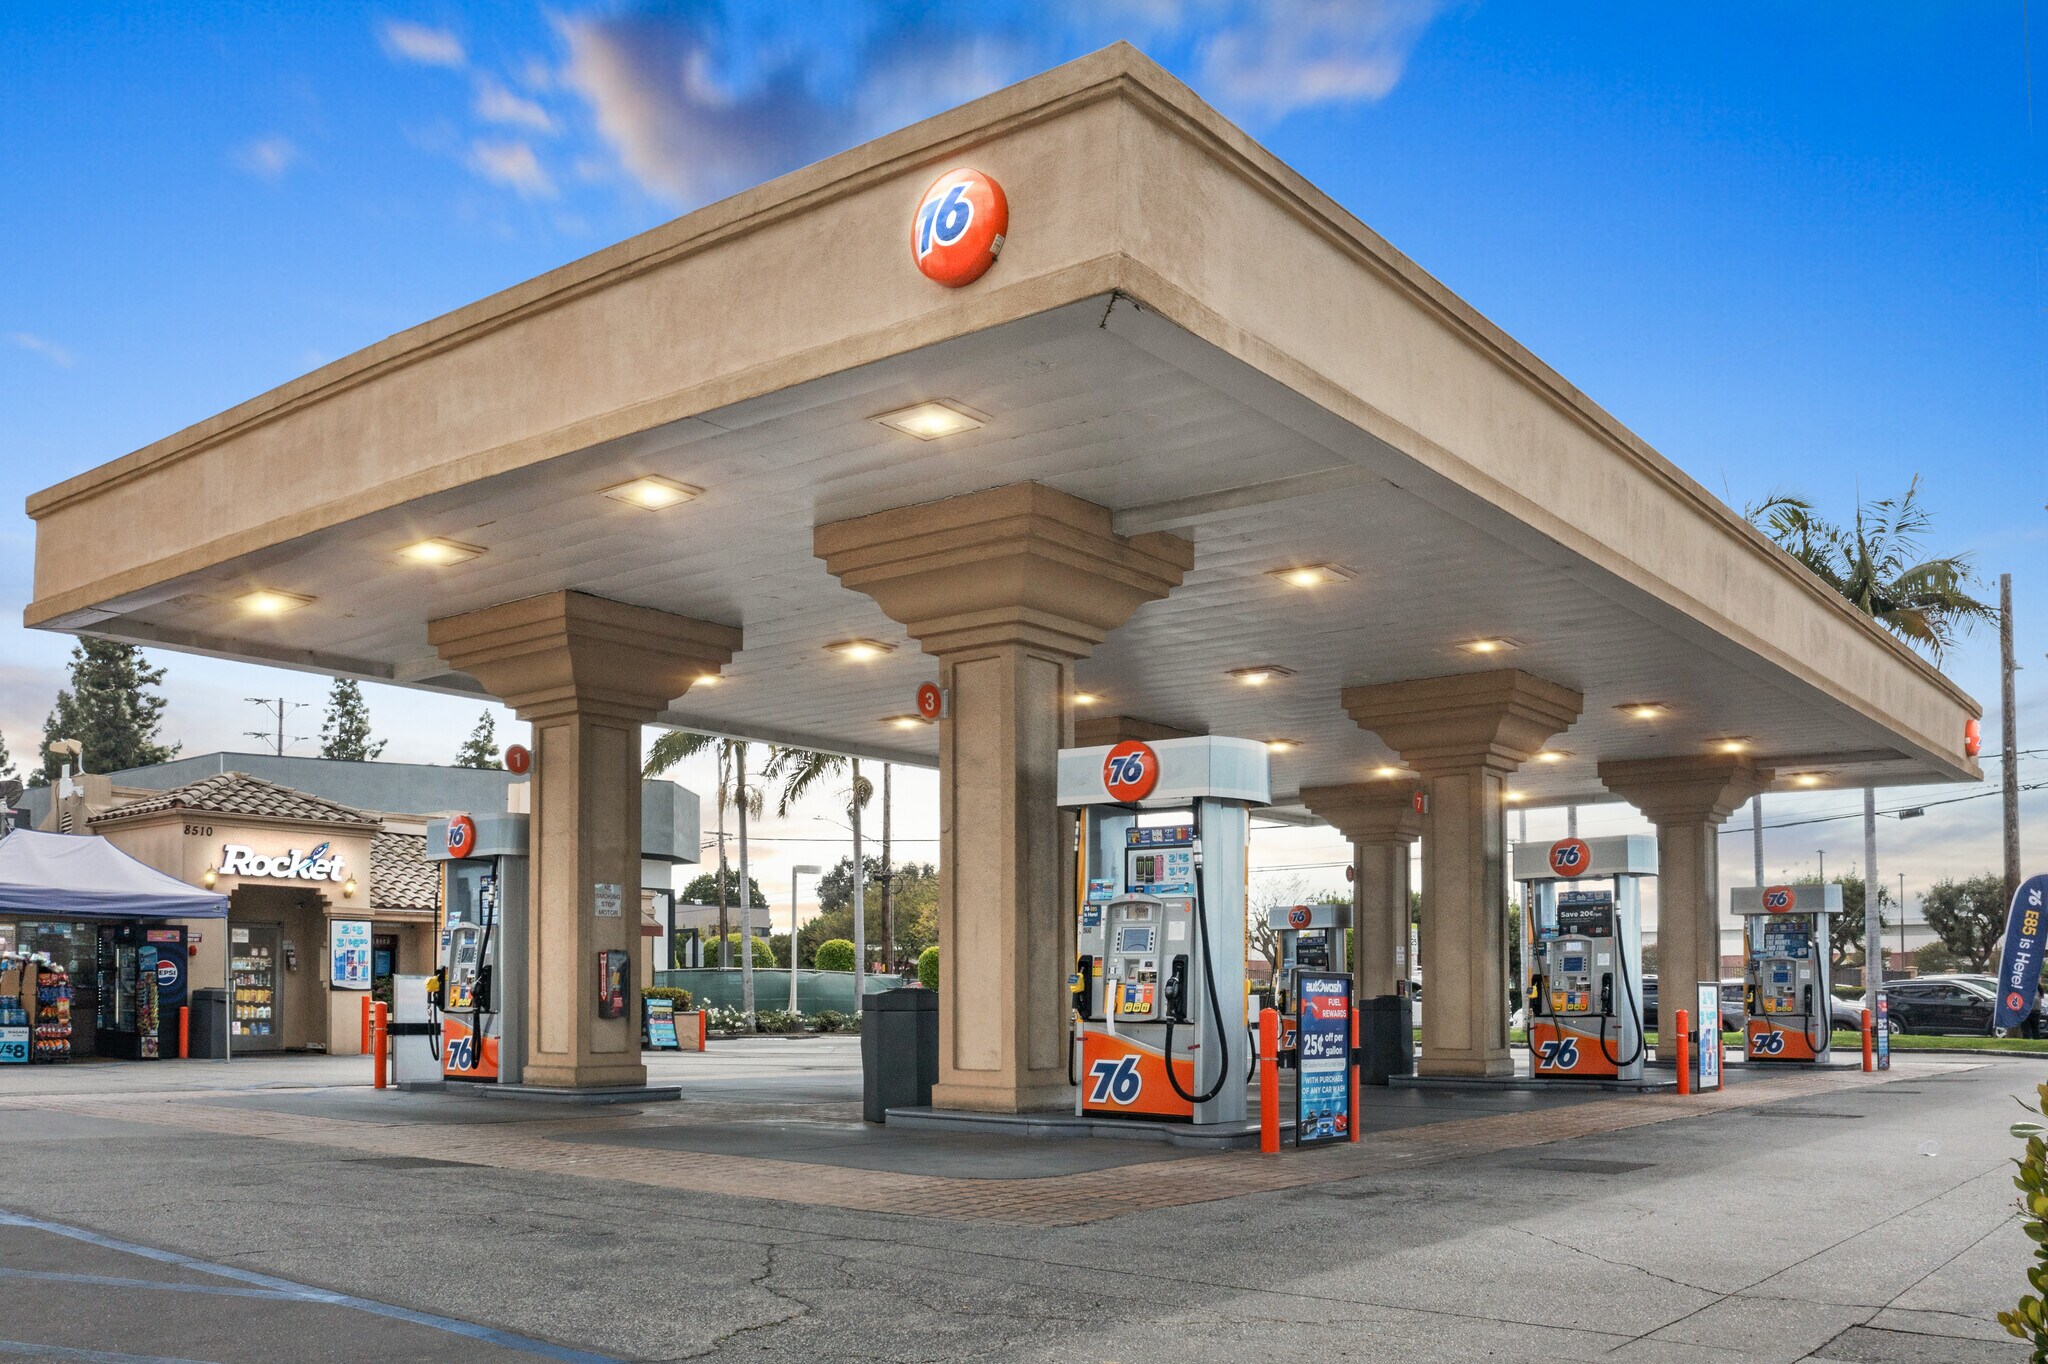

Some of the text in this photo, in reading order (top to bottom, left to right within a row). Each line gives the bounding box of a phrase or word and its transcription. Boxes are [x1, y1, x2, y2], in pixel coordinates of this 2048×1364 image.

[918, 180, 975, 261] 76
[925, 692, 935, 711] 3
[514, 752, 521, 768] 1
[1109, 751, 1146, 786] 76
[1416, 797, 1422, 809] 7
[184, 825, 213, 837] 8510
[448, 823, 466, 848] 76
[219, 842, 346, 882] Rocket
[1555, 844, 1580, 867] 76
[1184, 901, 1191, 913] 3
[1767, 890, 1788, 907] 76
[1292, 909, 1307, 924] 76
[2011, 888, 2042, 989] 76 E85 is Here!
[1306, 979, 1342, 994] autowash
[1328, 998, 1342, 1007] FUEL
[2011, 995, 2020, 1008] 76
[1322, 1009, 1347, 1018] REWARDS
[1285, 1029, 1297, 1048] 7
[1303, 1033, 1324, 1056] 25¢
[1325, 1032, 1344, 1044] off per
[1752, 1030, 1785, 1055] 76
[447, 1035, 473, 1072] 76
[1325, 1045, 1343, 1057] gallon
[1539, 1037, 1580, 1070] 76
[1088, 1054, 1143, 1106] 76
[1304, 1075, 1344, 1084] WITH PURCHASE
[1301, 1084, 1346, 1095] OF ANY CAR WASH
